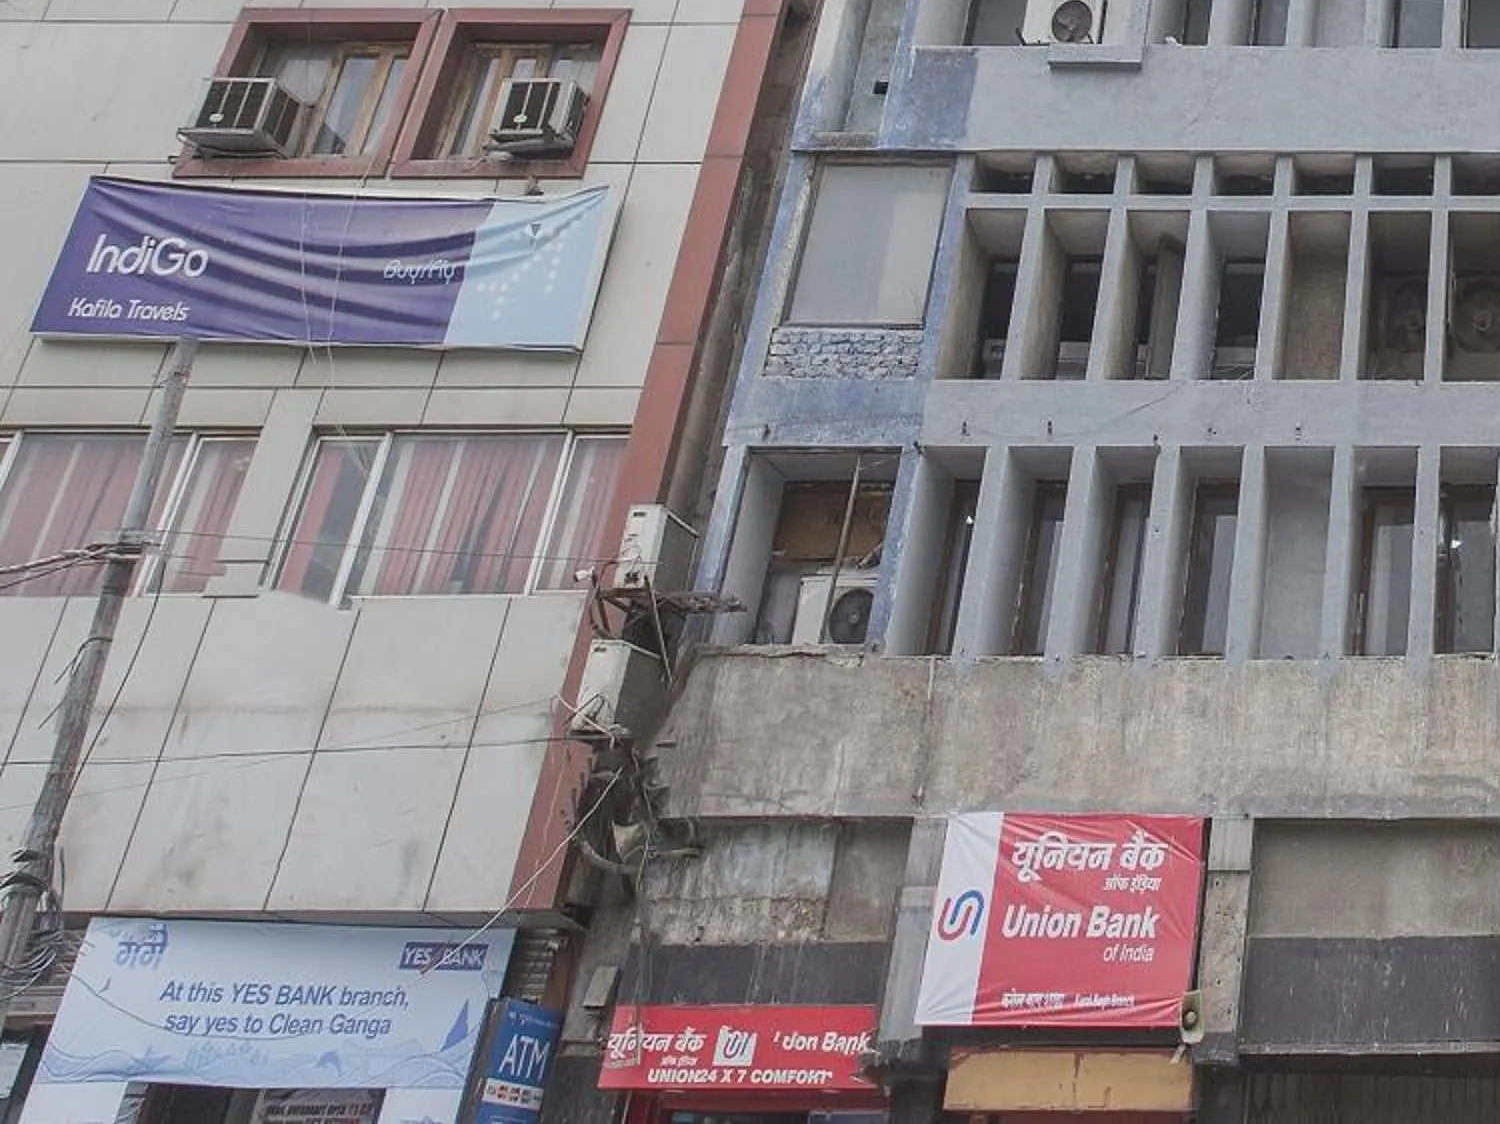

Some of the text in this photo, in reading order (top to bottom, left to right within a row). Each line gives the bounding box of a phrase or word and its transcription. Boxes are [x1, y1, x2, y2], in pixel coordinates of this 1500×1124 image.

[86, 233, 209, 276] IndiGo
[68, 297, 191, 321] Kafila Travels
[1011, 830, 1168, 882] यूनियन बैंक
[1001, 904, 1160, 939] Union Bank
[403, 943, 433, 966] YES
[1103, 943, 1155, 963] of India
[159, 980, 411, 1010] At this YES BANK branch,
[163, 1013, 392, 1040] say yes to Clean Ganga
[498, 1034, 551, 1082] ATM
[722, 1068, 733, 1082] X
[736, 1069, 748, 1082] 7
